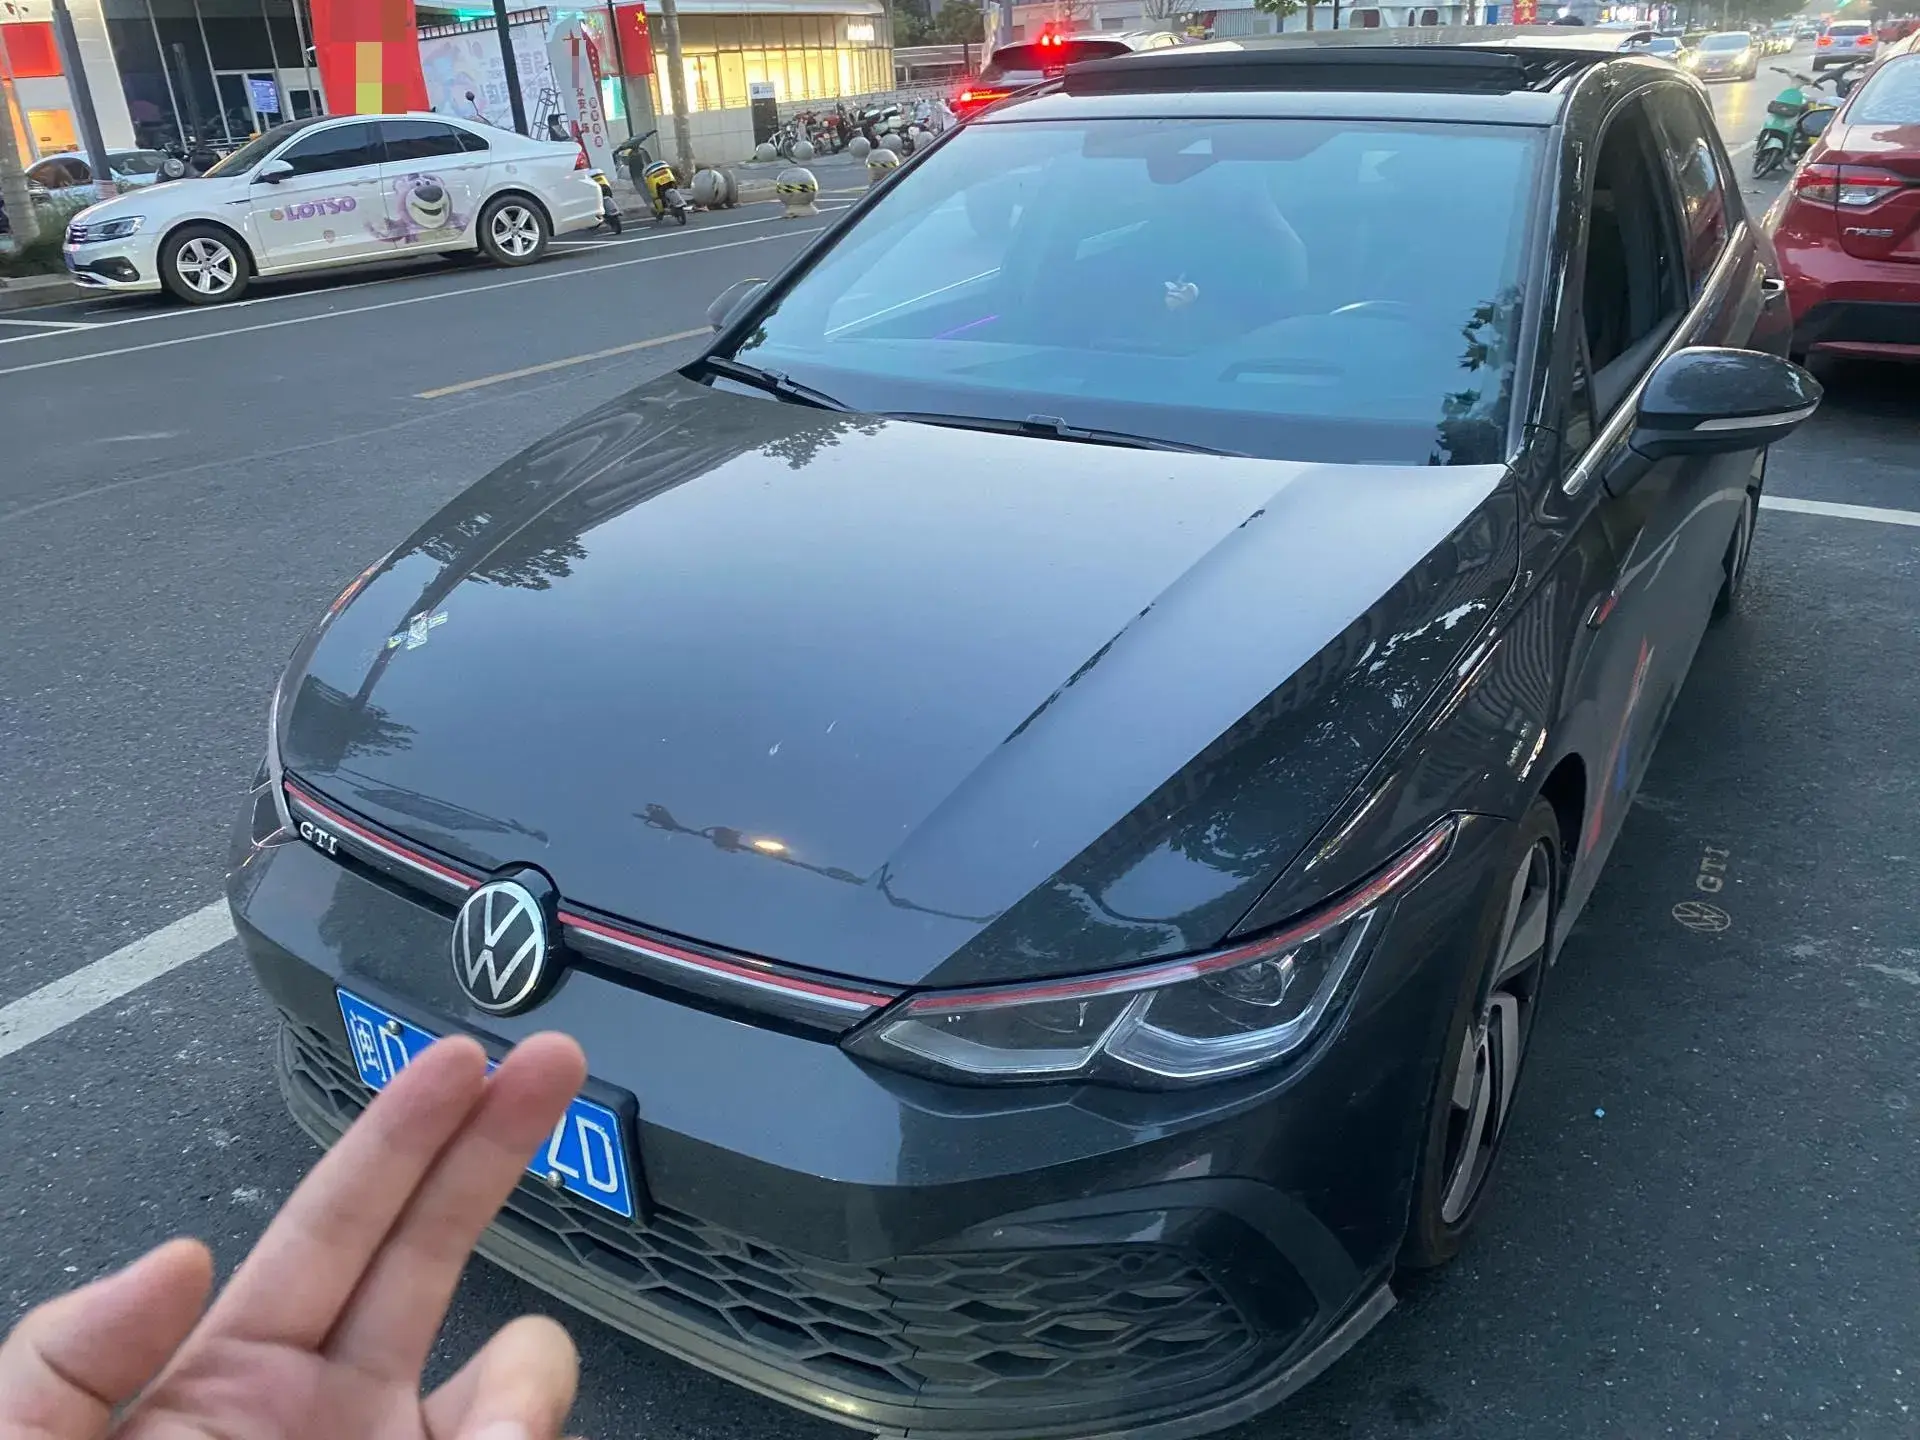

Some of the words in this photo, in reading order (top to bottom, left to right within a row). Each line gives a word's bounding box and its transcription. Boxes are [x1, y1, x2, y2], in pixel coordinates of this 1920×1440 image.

[284, 196, 357, 221] LOTSO
[300, 821, 338, 855] GTI
[1696, 846, 1730, 893] GTI
